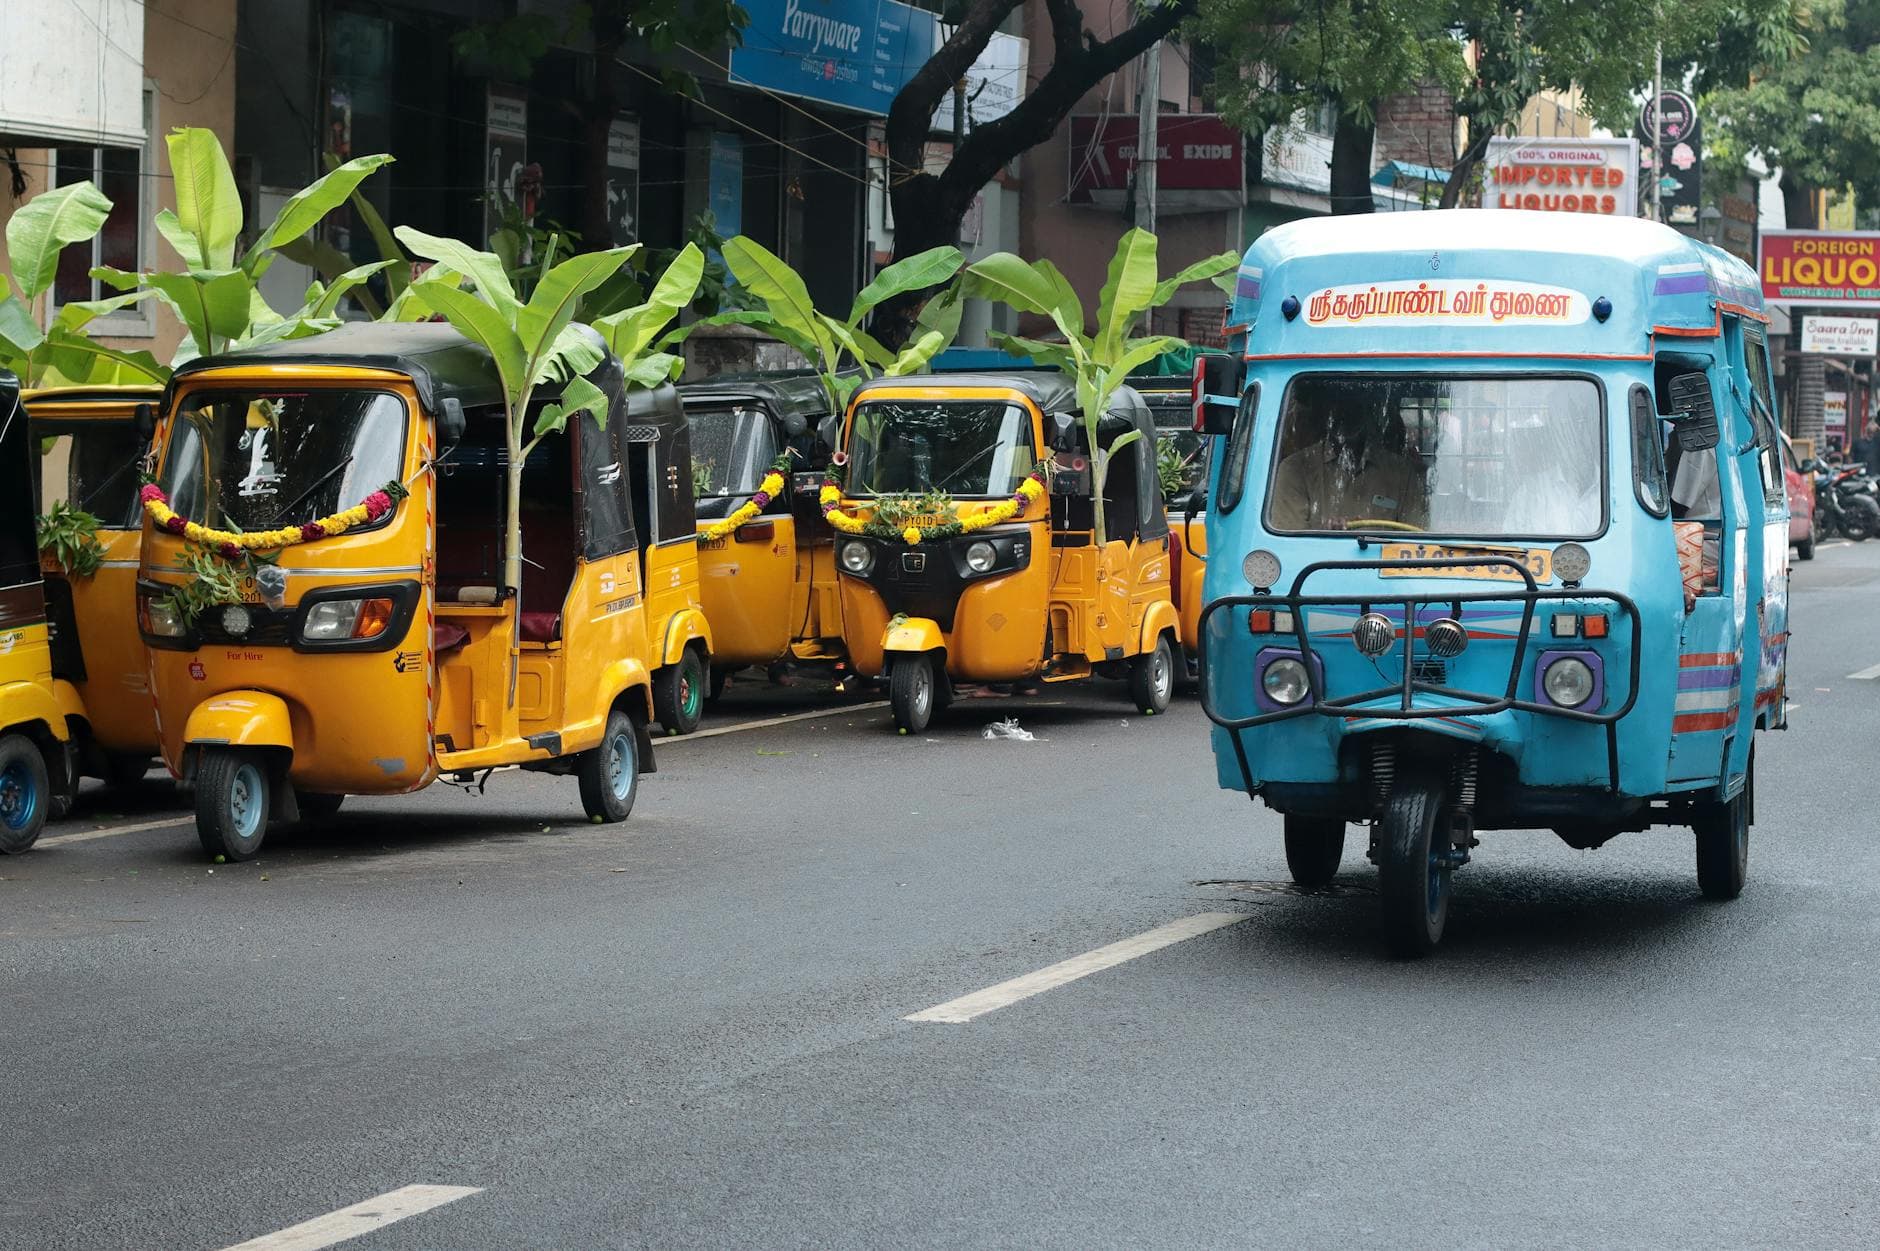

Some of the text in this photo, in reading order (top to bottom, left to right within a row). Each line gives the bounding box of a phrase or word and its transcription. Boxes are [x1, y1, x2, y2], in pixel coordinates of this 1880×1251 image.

[782, 0, 861, 53] Parryware
[1183, 144, 1233, 160] EXIDE
[1516, 150, 1602, 161] 100% ORIGINAL
[1494, 165, 1624, 187] IMPORTED
[1499, 192, 1616, 214] LIQUORS
[1793, 240, 1874, 255] FOREIGN
[1765, 256, 1880, 286] LIQUO
[1489, 292, 1571, 320] துணை
[1807, 320, 1874, 335] Saara Inn
[226, 651, 264, 662] For Hire
